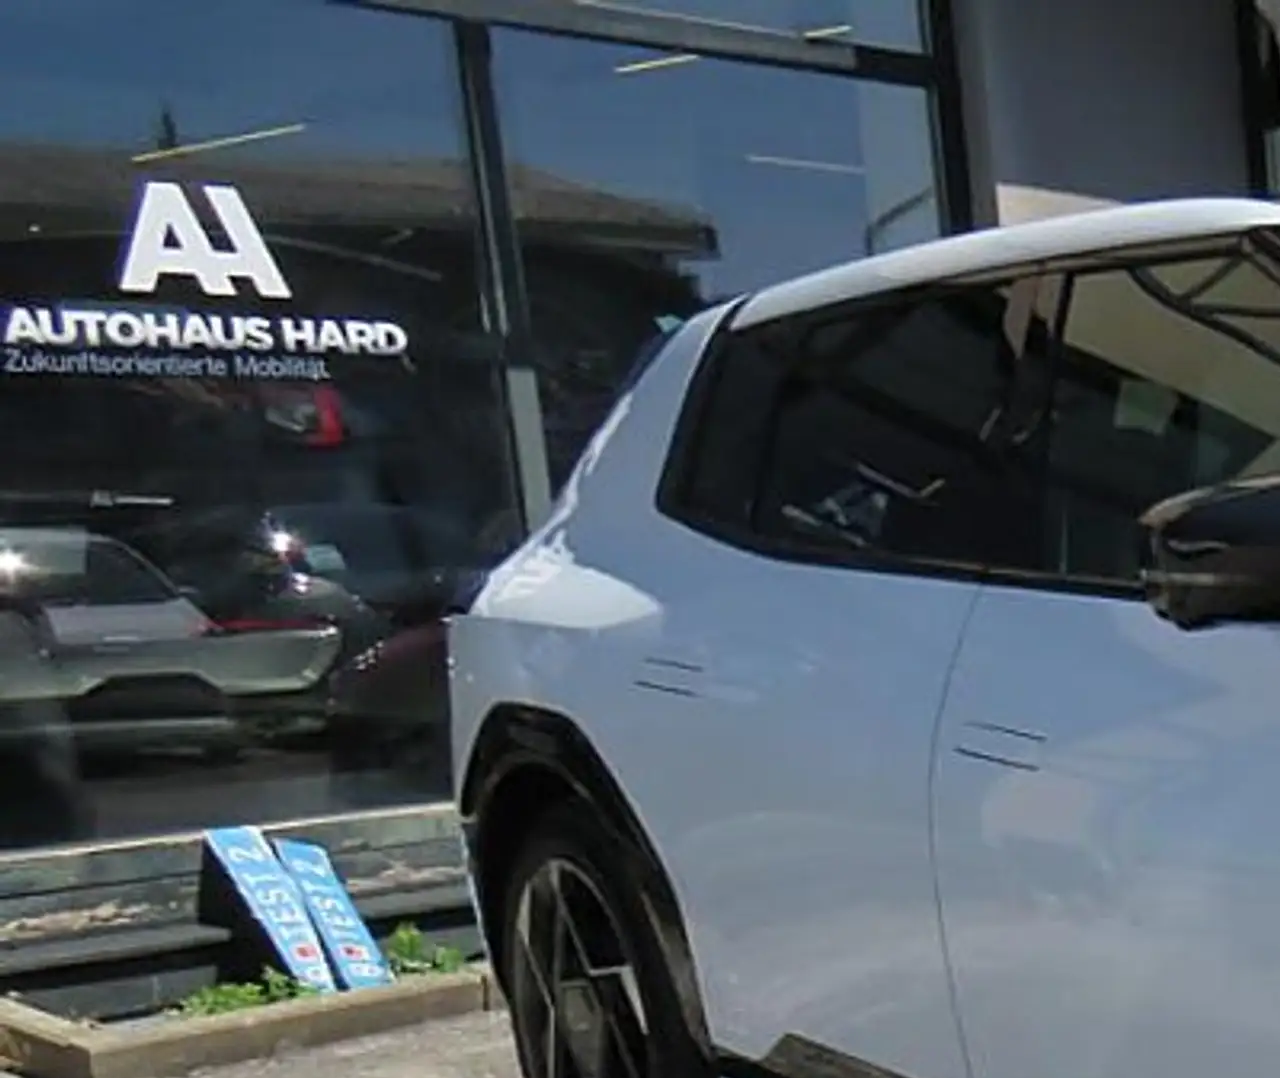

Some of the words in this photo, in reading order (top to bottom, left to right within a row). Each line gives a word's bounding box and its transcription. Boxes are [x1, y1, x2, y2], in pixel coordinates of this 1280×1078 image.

[4, 308, 276, 351] AUTOHAUS
[281, 319, 408, 354] HARD
[4, 350, 227, 377] Zukunftsorientierte
